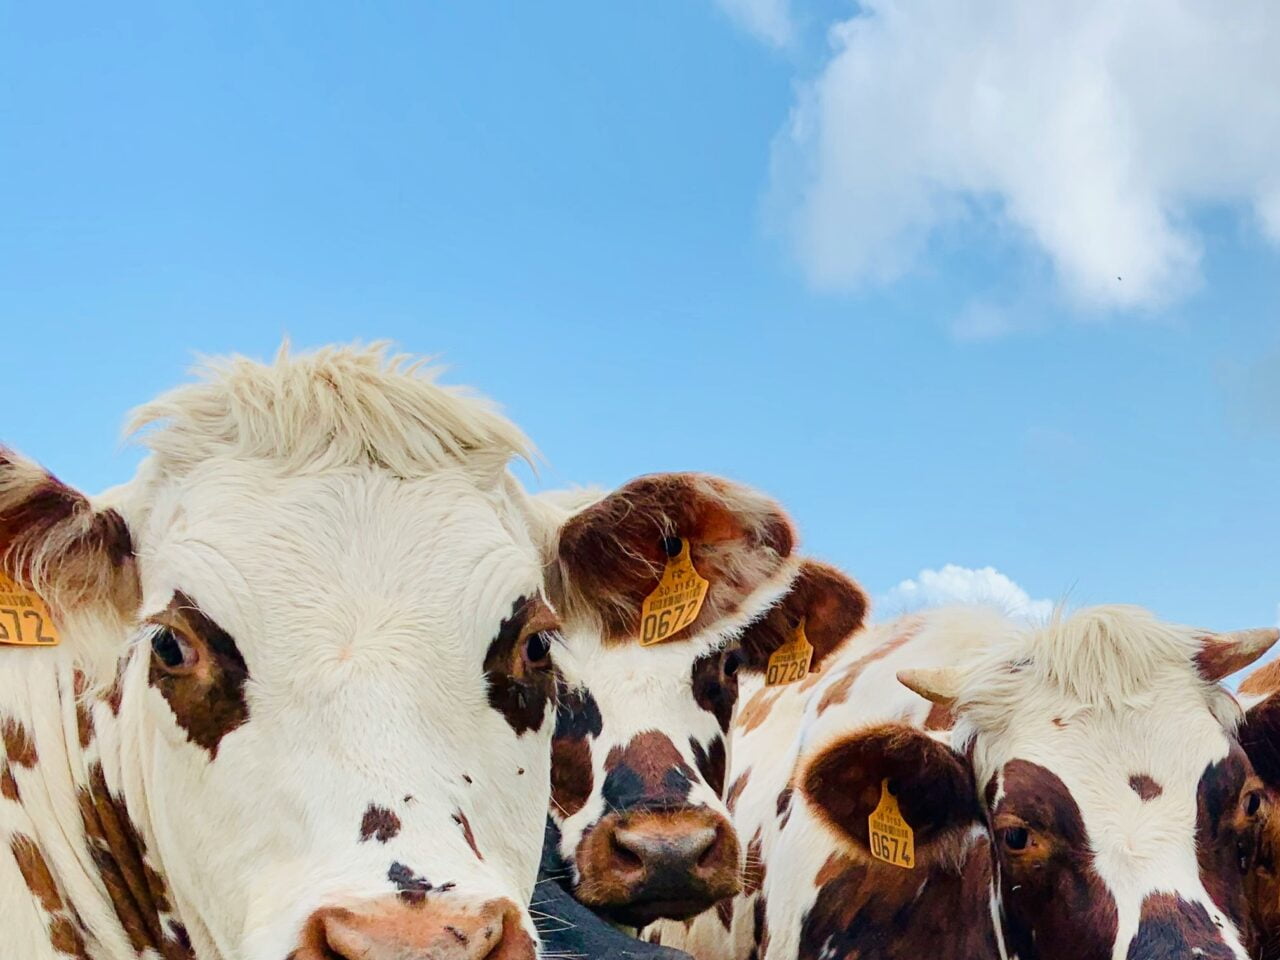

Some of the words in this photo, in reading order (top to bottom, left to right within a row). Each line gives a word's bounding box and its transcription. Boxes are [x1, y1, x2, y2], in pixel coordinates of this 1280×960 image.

[643, 599, 698, 643] 0672
[768, 658, 807, 685] 0728
[872, 831, 911, 866] 0674
